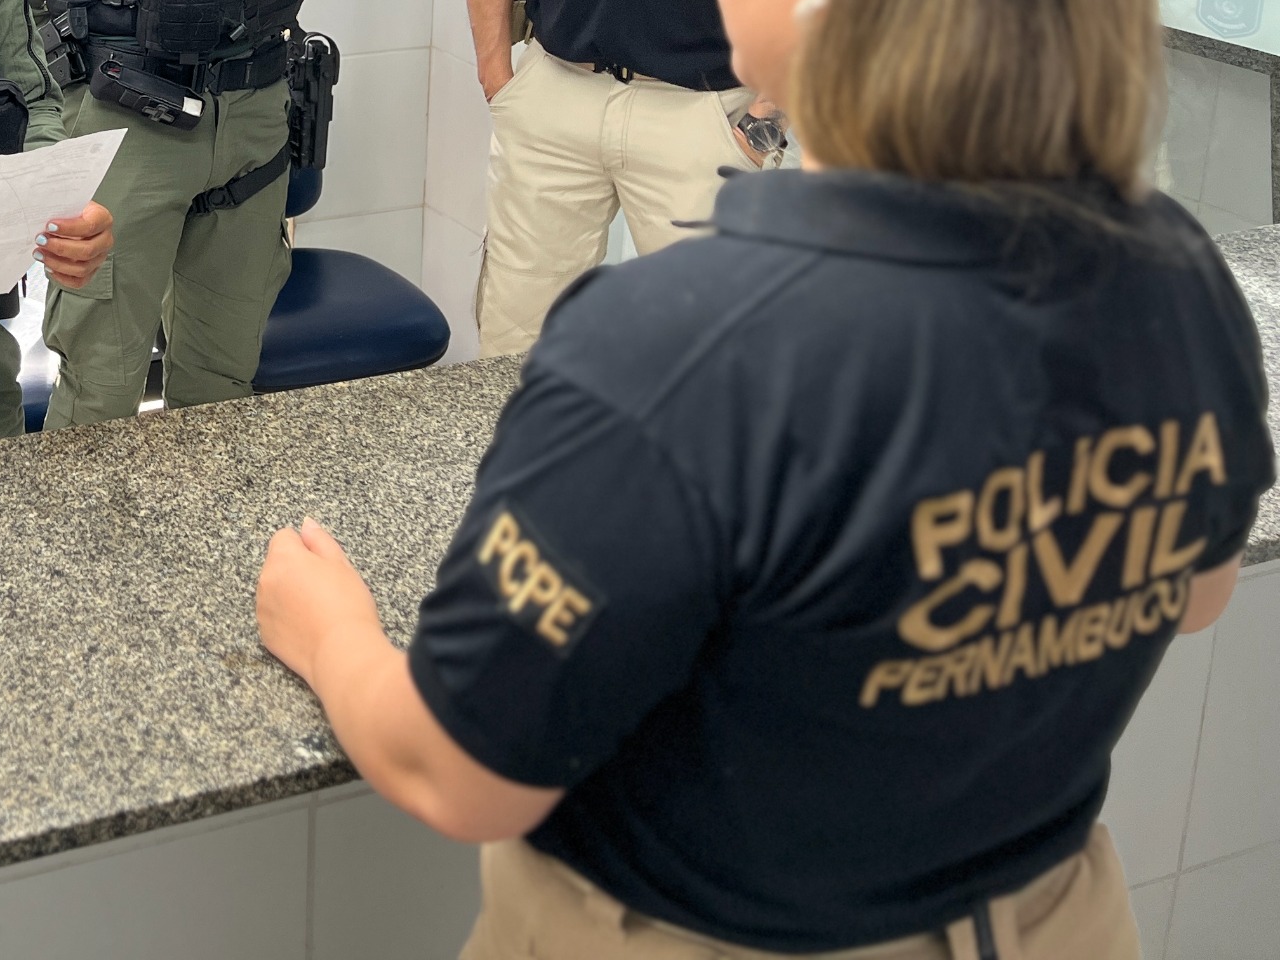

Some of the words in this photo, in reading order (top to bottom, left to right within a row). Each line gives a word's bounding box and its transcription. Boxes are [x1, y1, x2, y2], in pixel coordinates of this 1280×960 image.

[479, 512, 593, 646] PCPE
[859, 569, 1193, 708] PERNAMBUCO
[896, 500, 1208, 652] CIVIL
